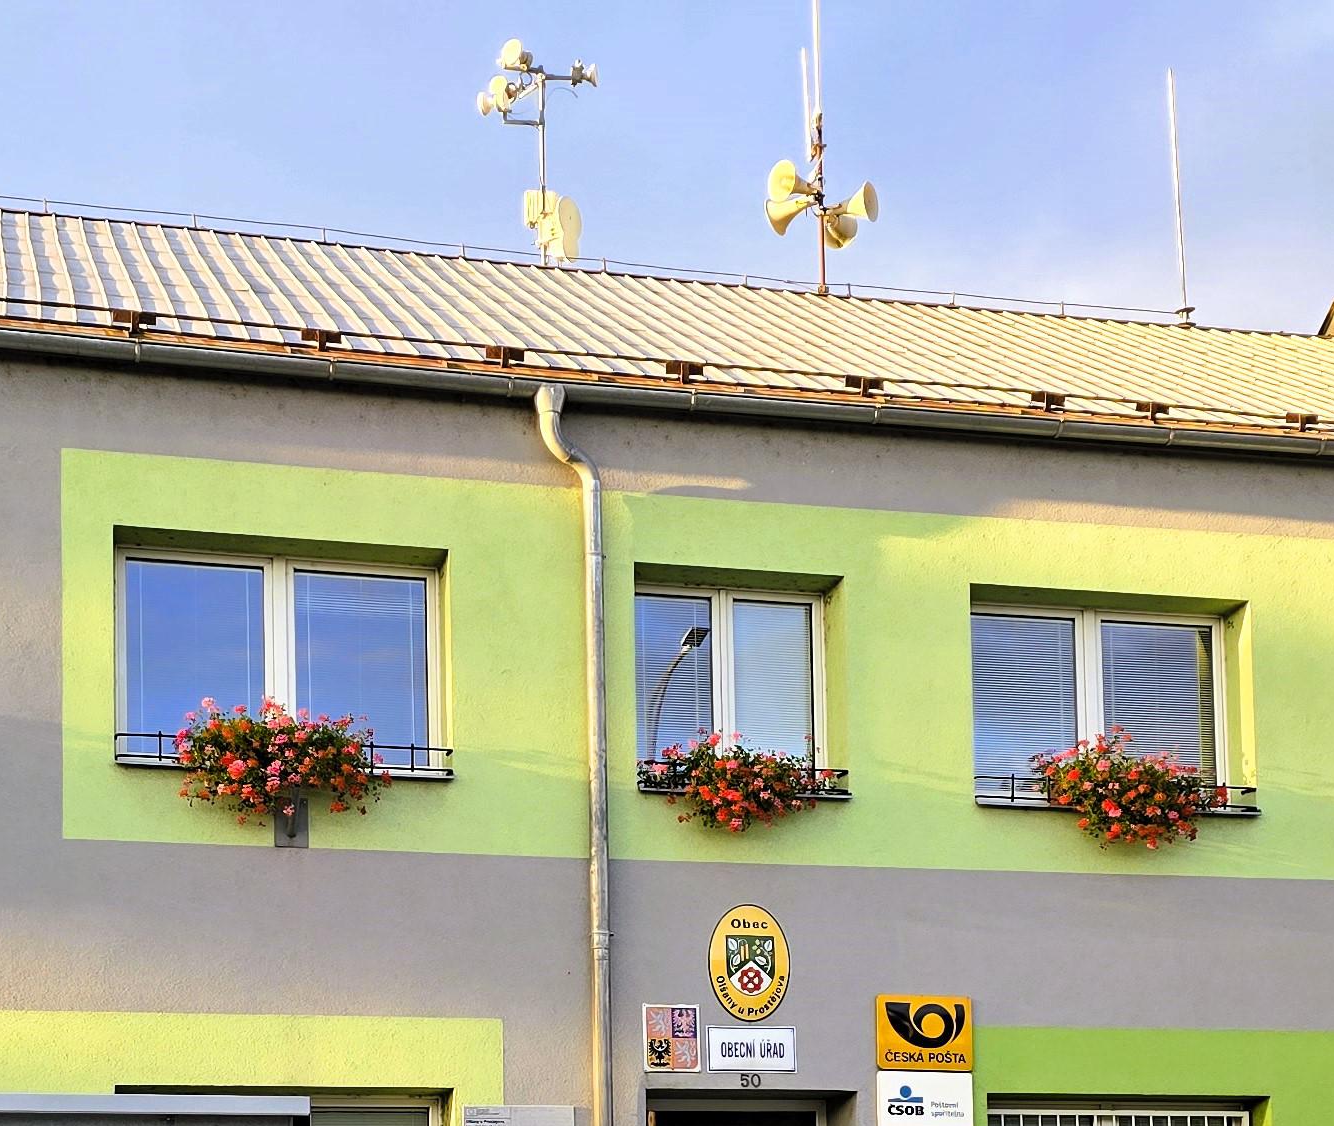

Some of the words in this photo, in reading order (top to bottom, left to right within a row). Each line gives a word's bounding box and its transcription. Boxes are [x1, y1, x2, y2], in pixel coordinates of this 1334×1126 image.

[730, 918, 769, 929] Obec
[738, 1006, 745, 1015] u
[747, 975, 785, 1016] Prostějova
[720, 1038, 756, 1058] OBECNÍ
[759, 1039, 785, 1059] ÚŘAD
[884, 1049, 925, 1063] ČESKÁ
[928, 1050, 967, 1064] POŠTA
[740, 1073, 762, 1089] 50
[887, 1103, 925, 1116] ČSOB
